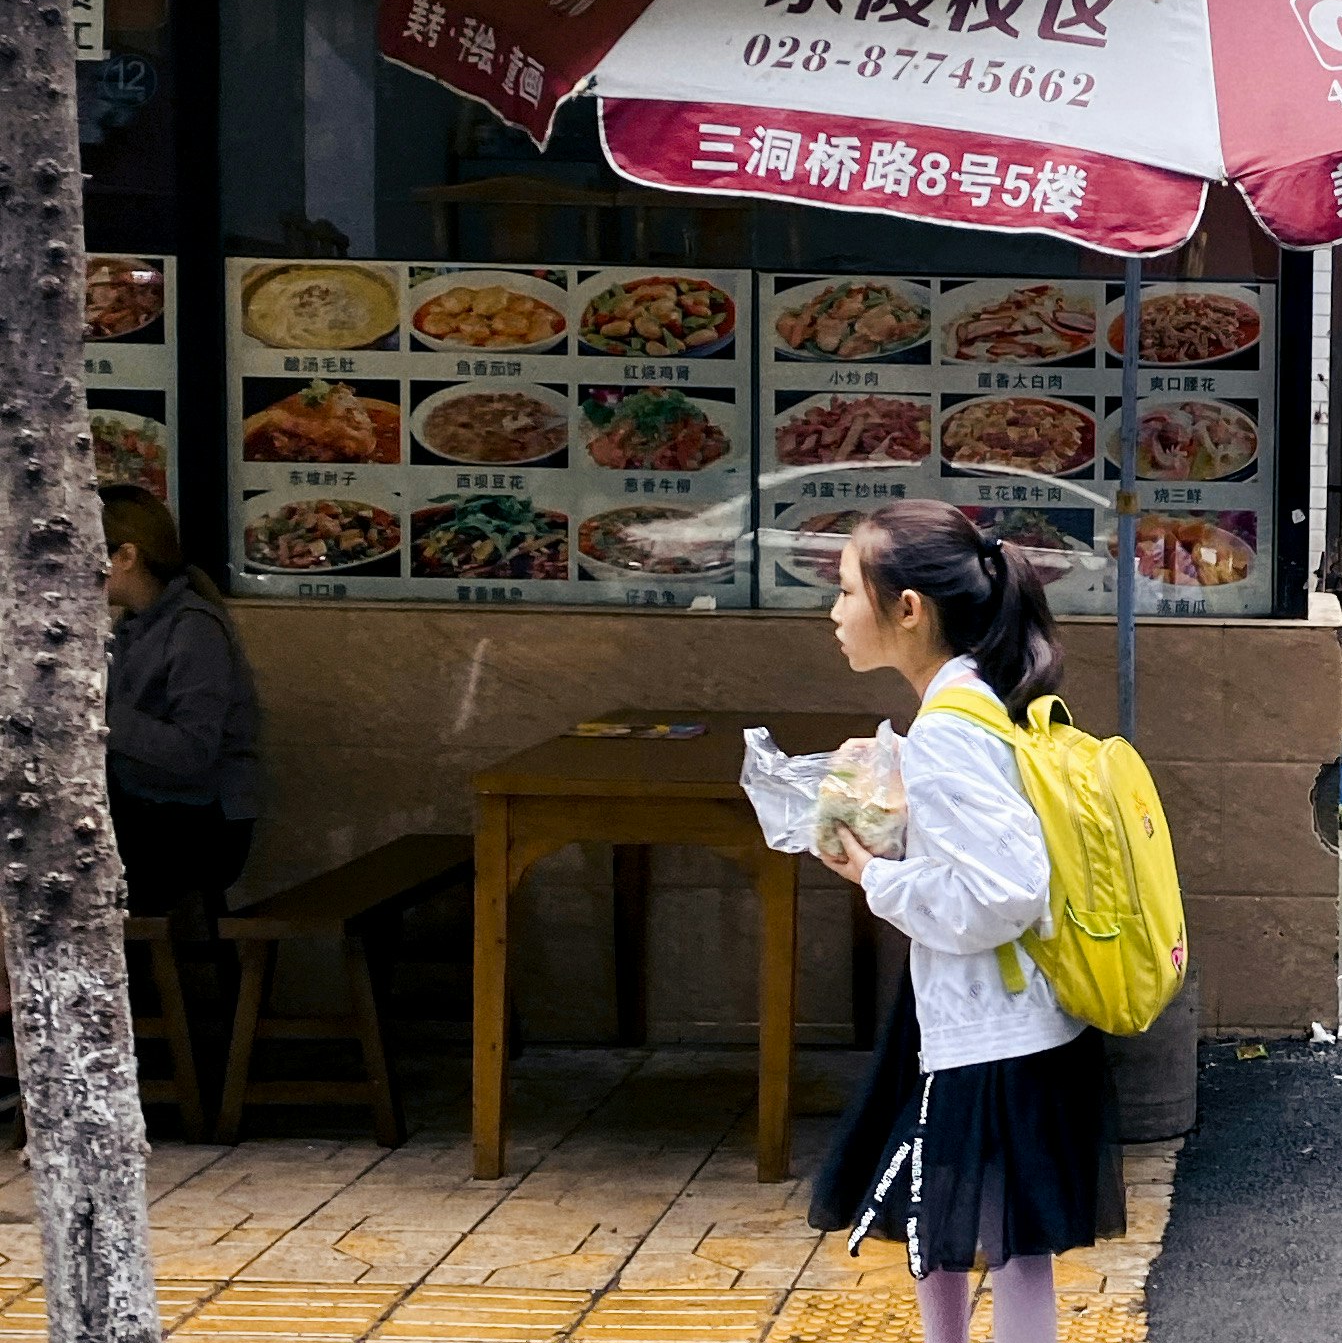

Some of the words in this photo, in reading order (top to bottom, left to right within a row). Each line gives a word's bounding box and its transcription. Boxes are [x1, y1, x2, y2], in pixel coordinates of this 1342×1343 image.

[114, 60, 146, 91] 12
[742, 32, 1097, 108] 028-87745662
[691, 121, 1090, 222] 三洞桥路8号5楼
[828, 370, 880, 387] 小炒肉
[1150, 376, 1216, 393] 爽口腰花
[1153, 487, 1202, 505] 烧三鲜
